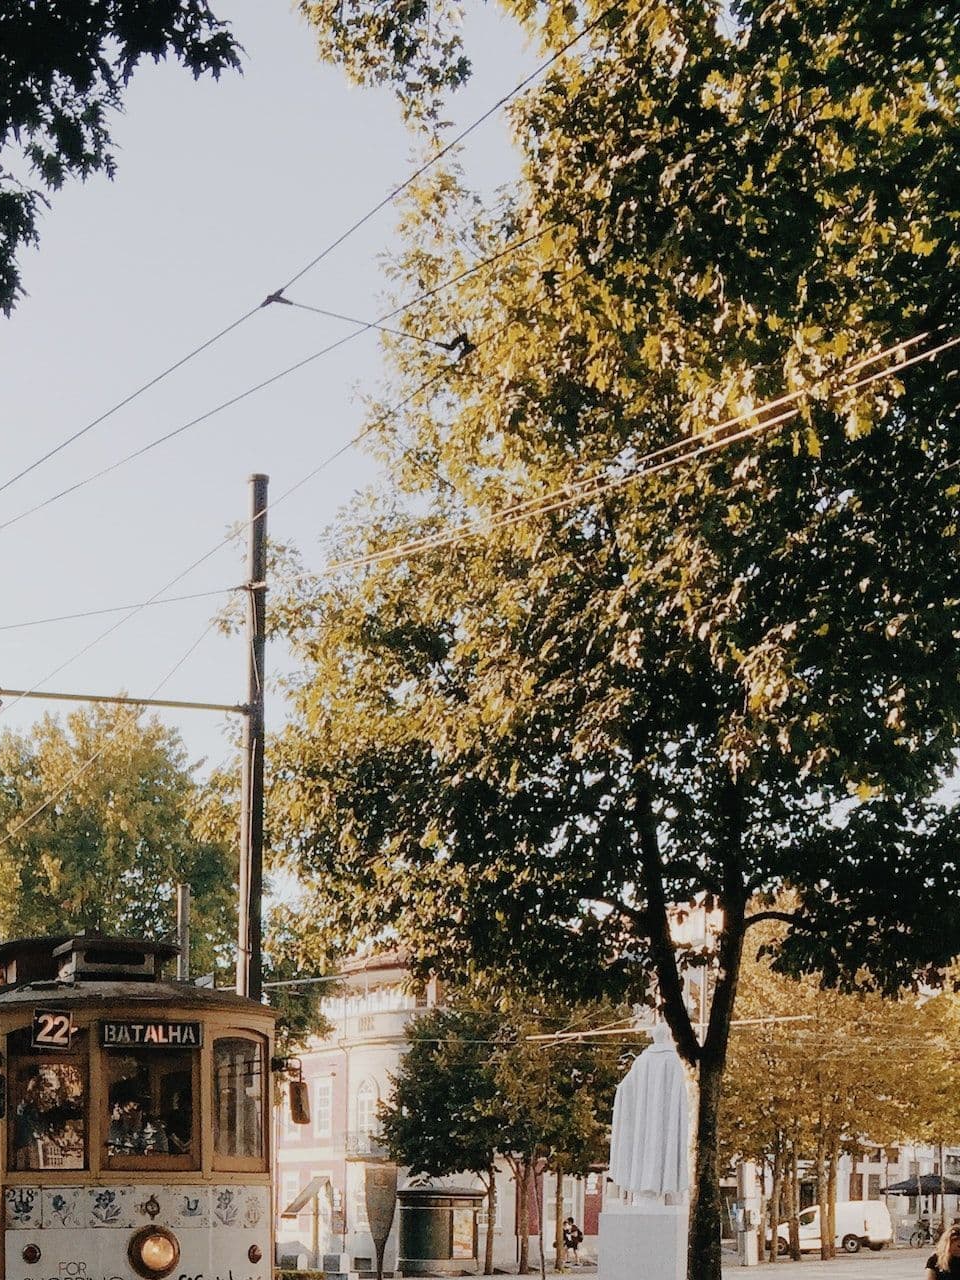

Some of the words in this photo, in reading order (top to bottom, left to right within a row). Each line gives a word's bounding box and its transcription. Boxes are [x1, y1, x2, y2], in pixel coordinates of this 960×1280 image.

[37, 1014, 70, 1044] 22
[104, 1024, 196, 1043] BATALHA
[7, 1188, 34, 1203] 218
[58, 1261, 87, 1276] FOR
